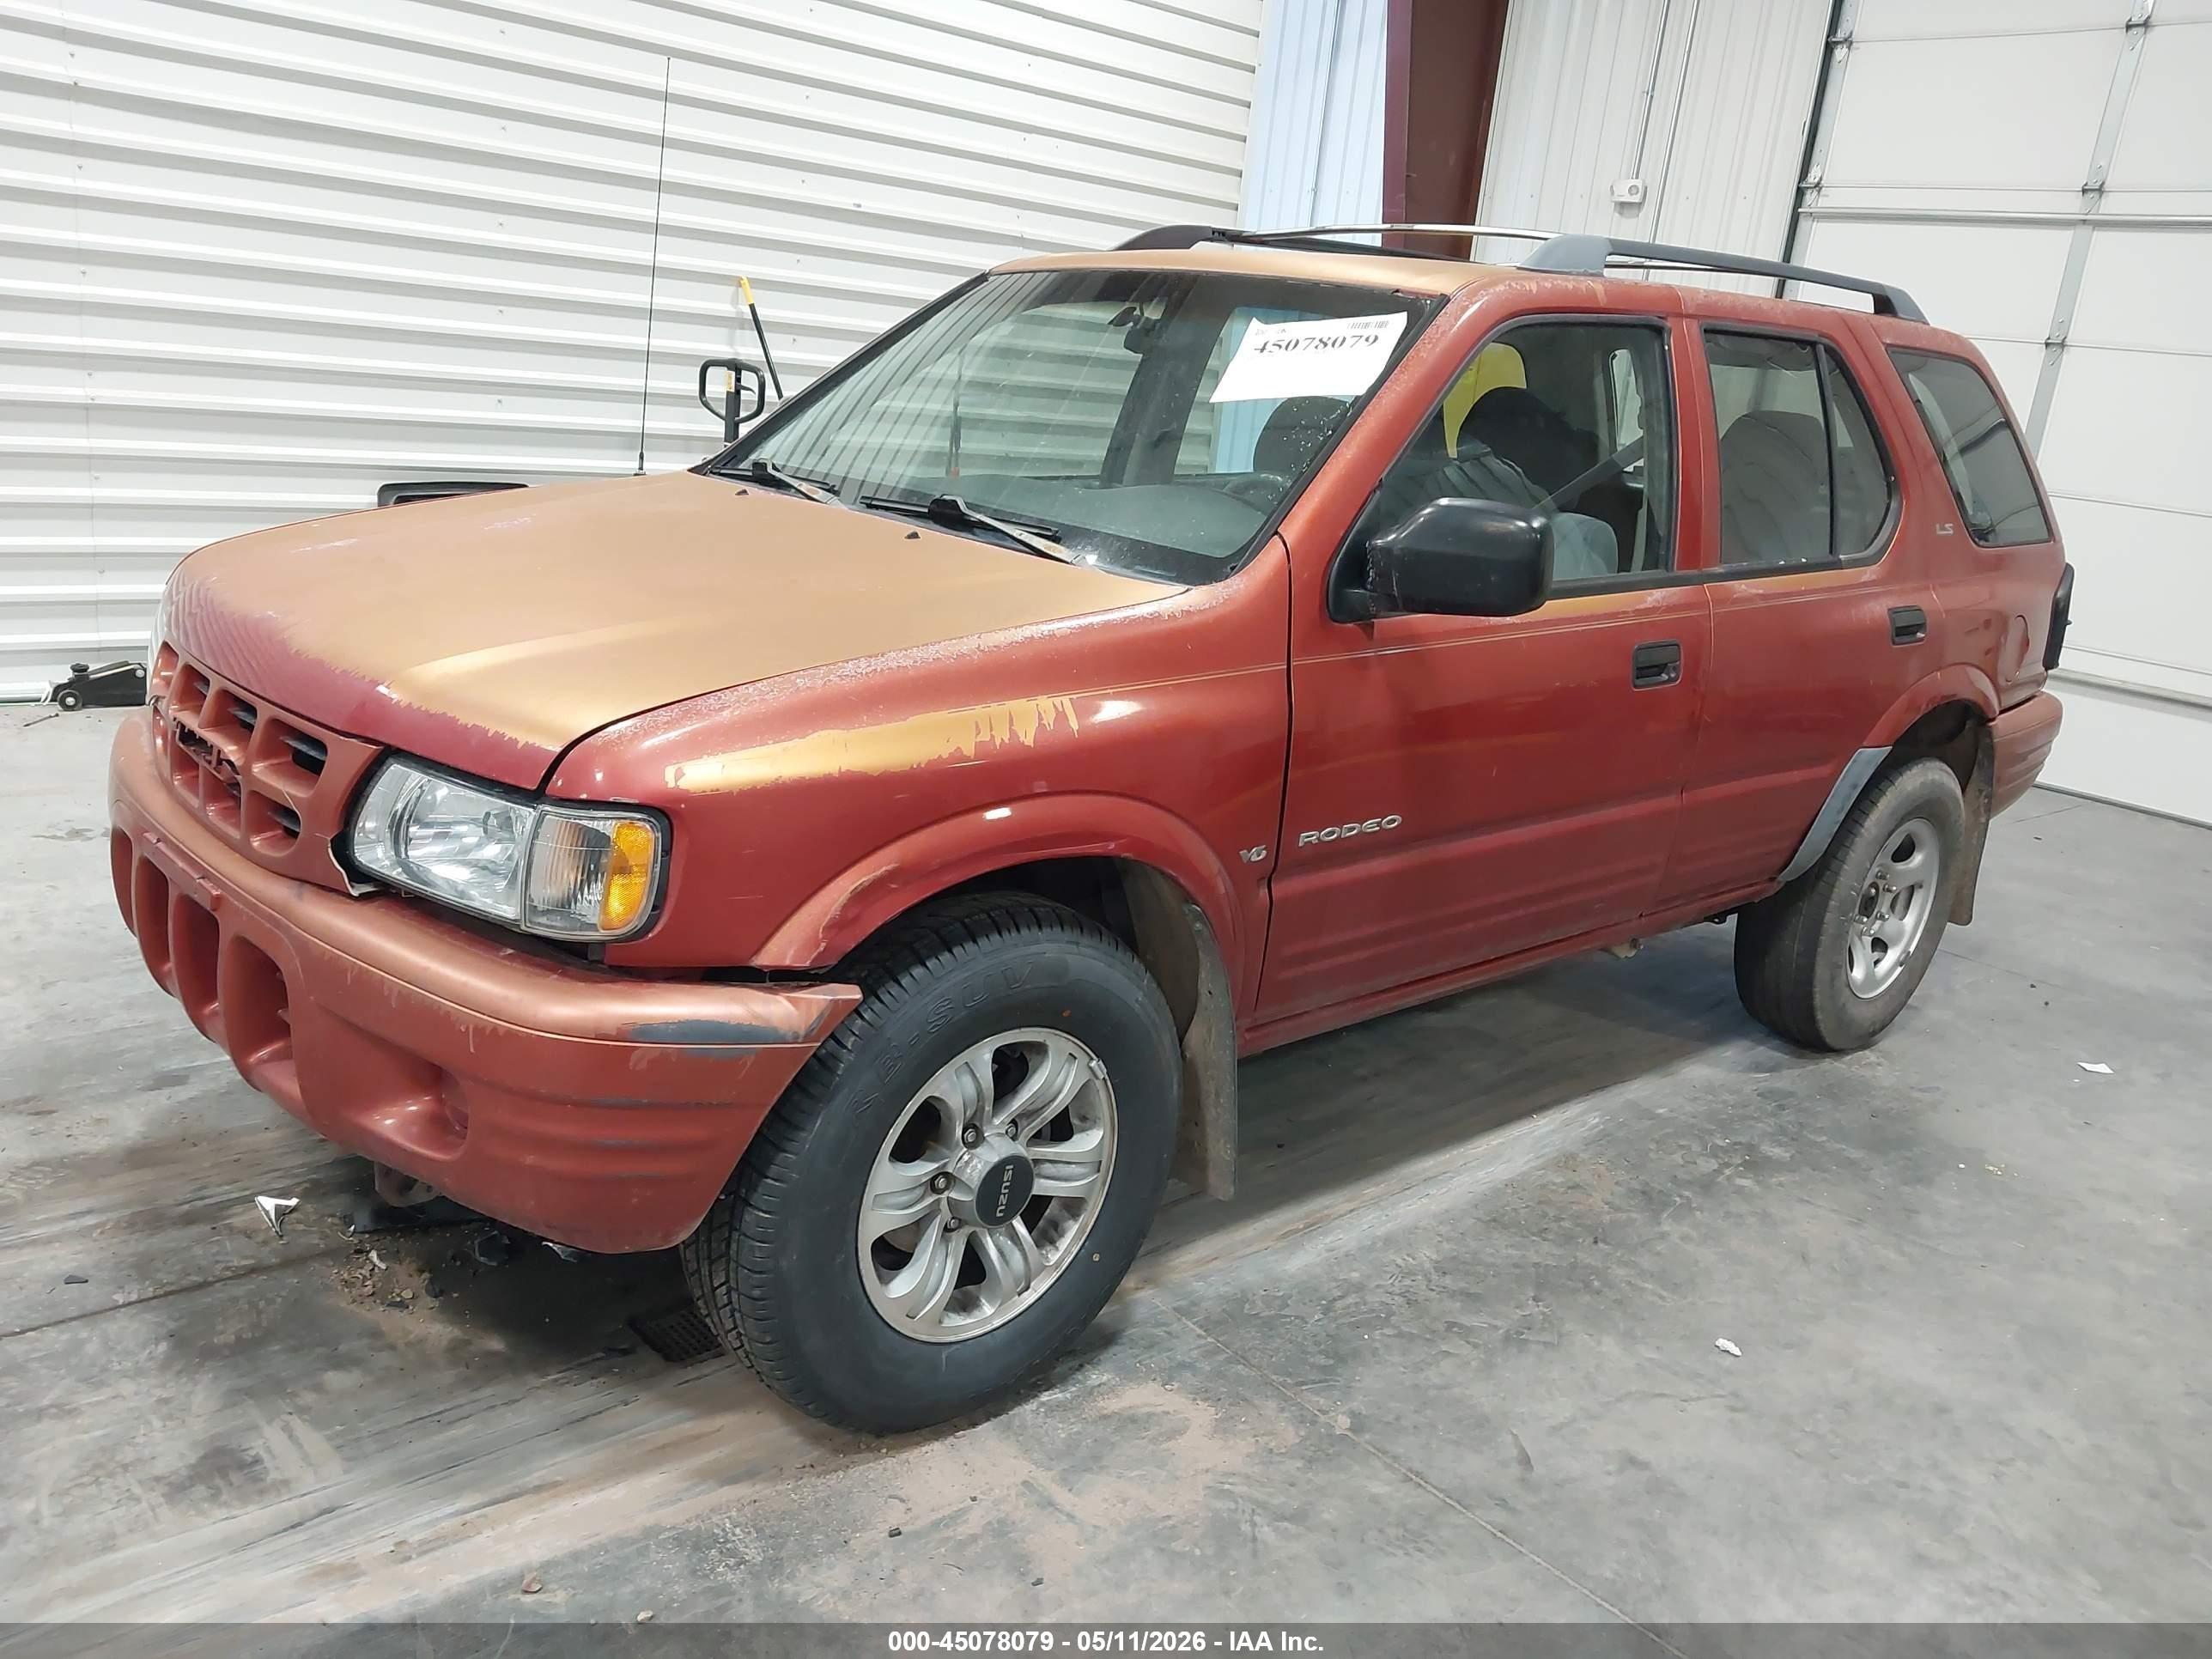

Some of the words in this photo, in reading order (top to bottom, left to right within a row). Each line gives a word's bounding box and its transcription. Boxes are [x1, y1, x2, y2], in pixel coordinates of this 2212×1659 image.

[1254, 333, 1380, 354] 45078079
[1935, 522, 1954, 535] LS
[1297, 814, 1402, 848] RODEO
[1239, 845, 1267, 864] V6
[995, 1164, 1014, 1218] ISUZU
